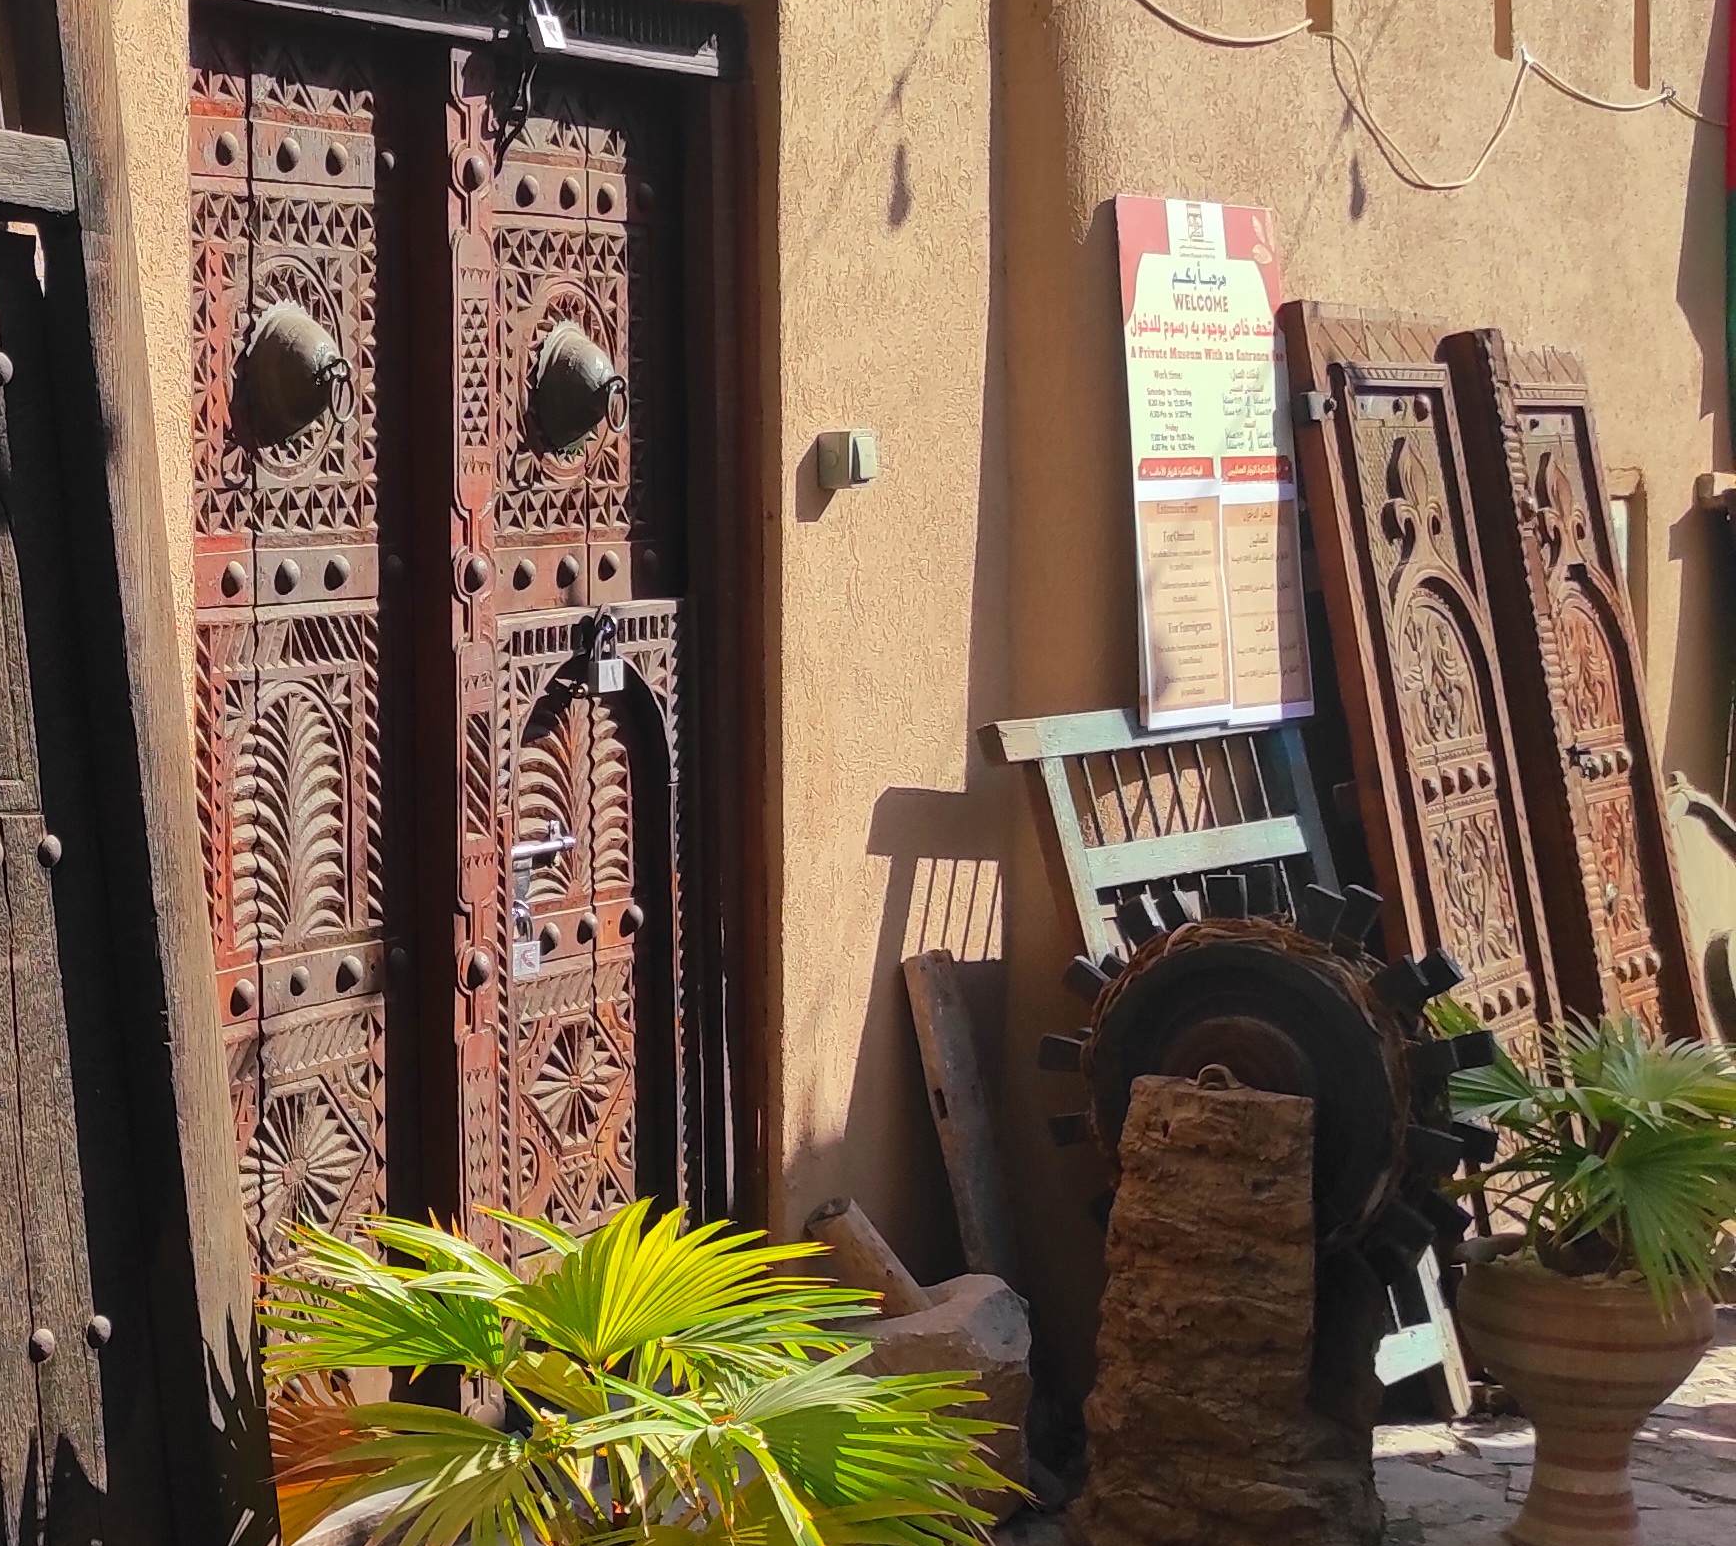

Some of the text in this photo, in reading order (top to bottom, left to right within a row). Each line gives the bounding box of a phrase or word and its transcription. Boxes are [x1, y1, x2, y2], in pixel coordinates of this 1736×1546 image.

[1172, 293, 1230, 313] WELCOME
[1131, 312, 1161, 338] للدخول
[1164, 321, 1188, 340] رسوم
[1131, 345, 1136, 358] A
[1139, 346, 1167, 359] Private
[1169, 347, 1203, 360] Museum
